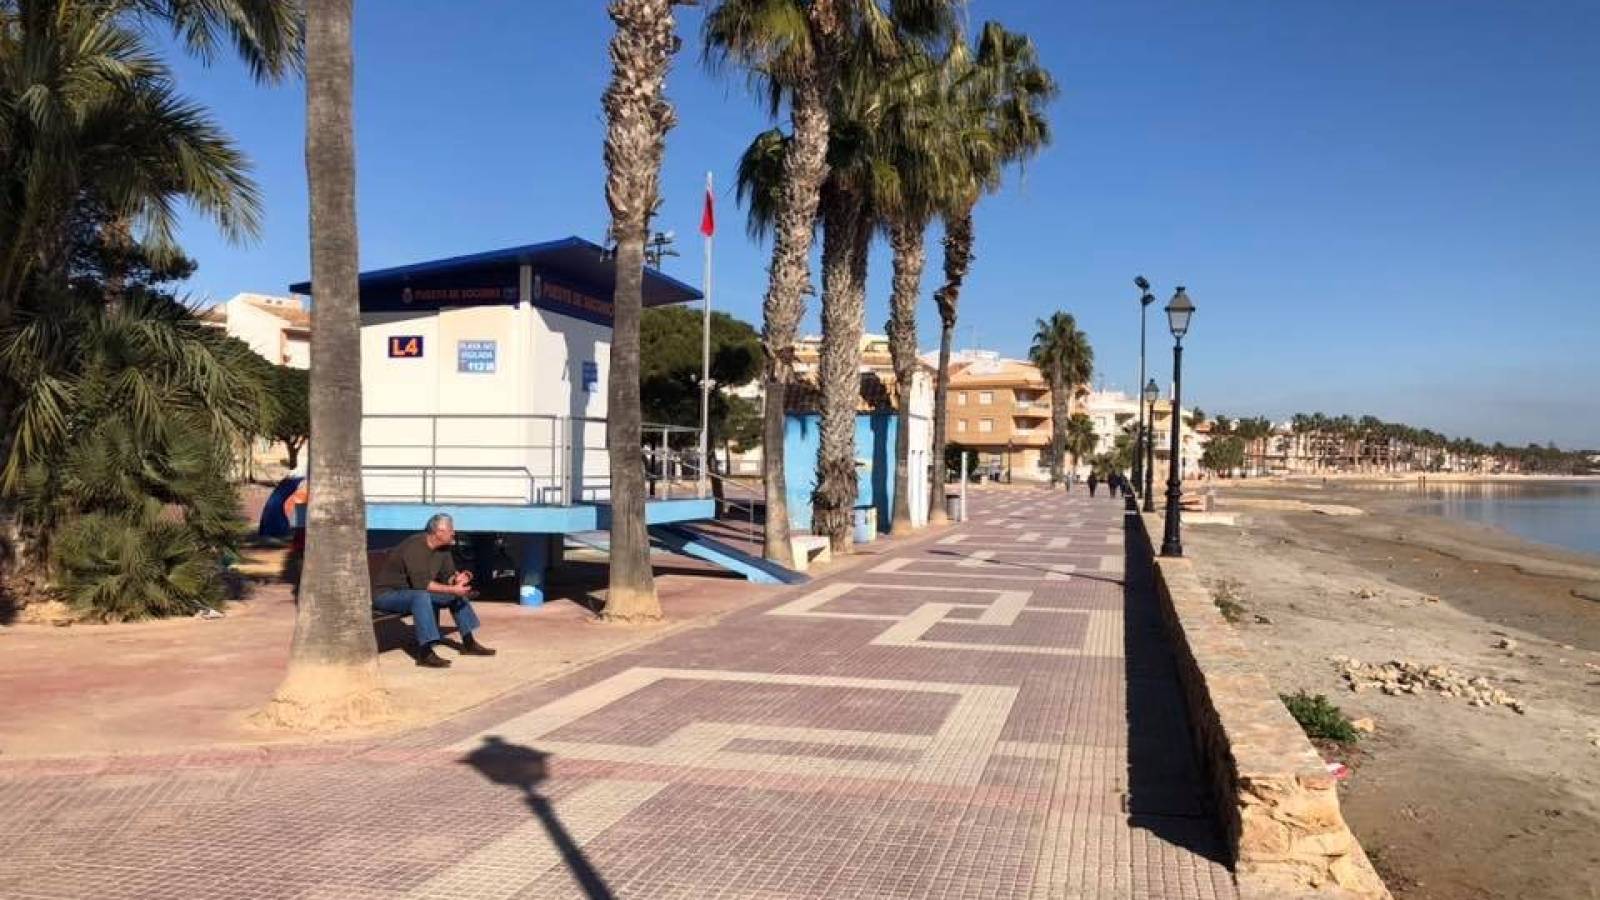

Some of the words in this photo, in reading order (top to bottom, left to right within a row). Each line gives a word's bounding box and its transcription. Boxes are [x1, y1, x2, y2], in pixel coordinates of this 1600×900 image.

[462, 287, 501, 300] SOCO
[584, 295, 615, 314] SOCO
[391, 338, 418, 356] L4
